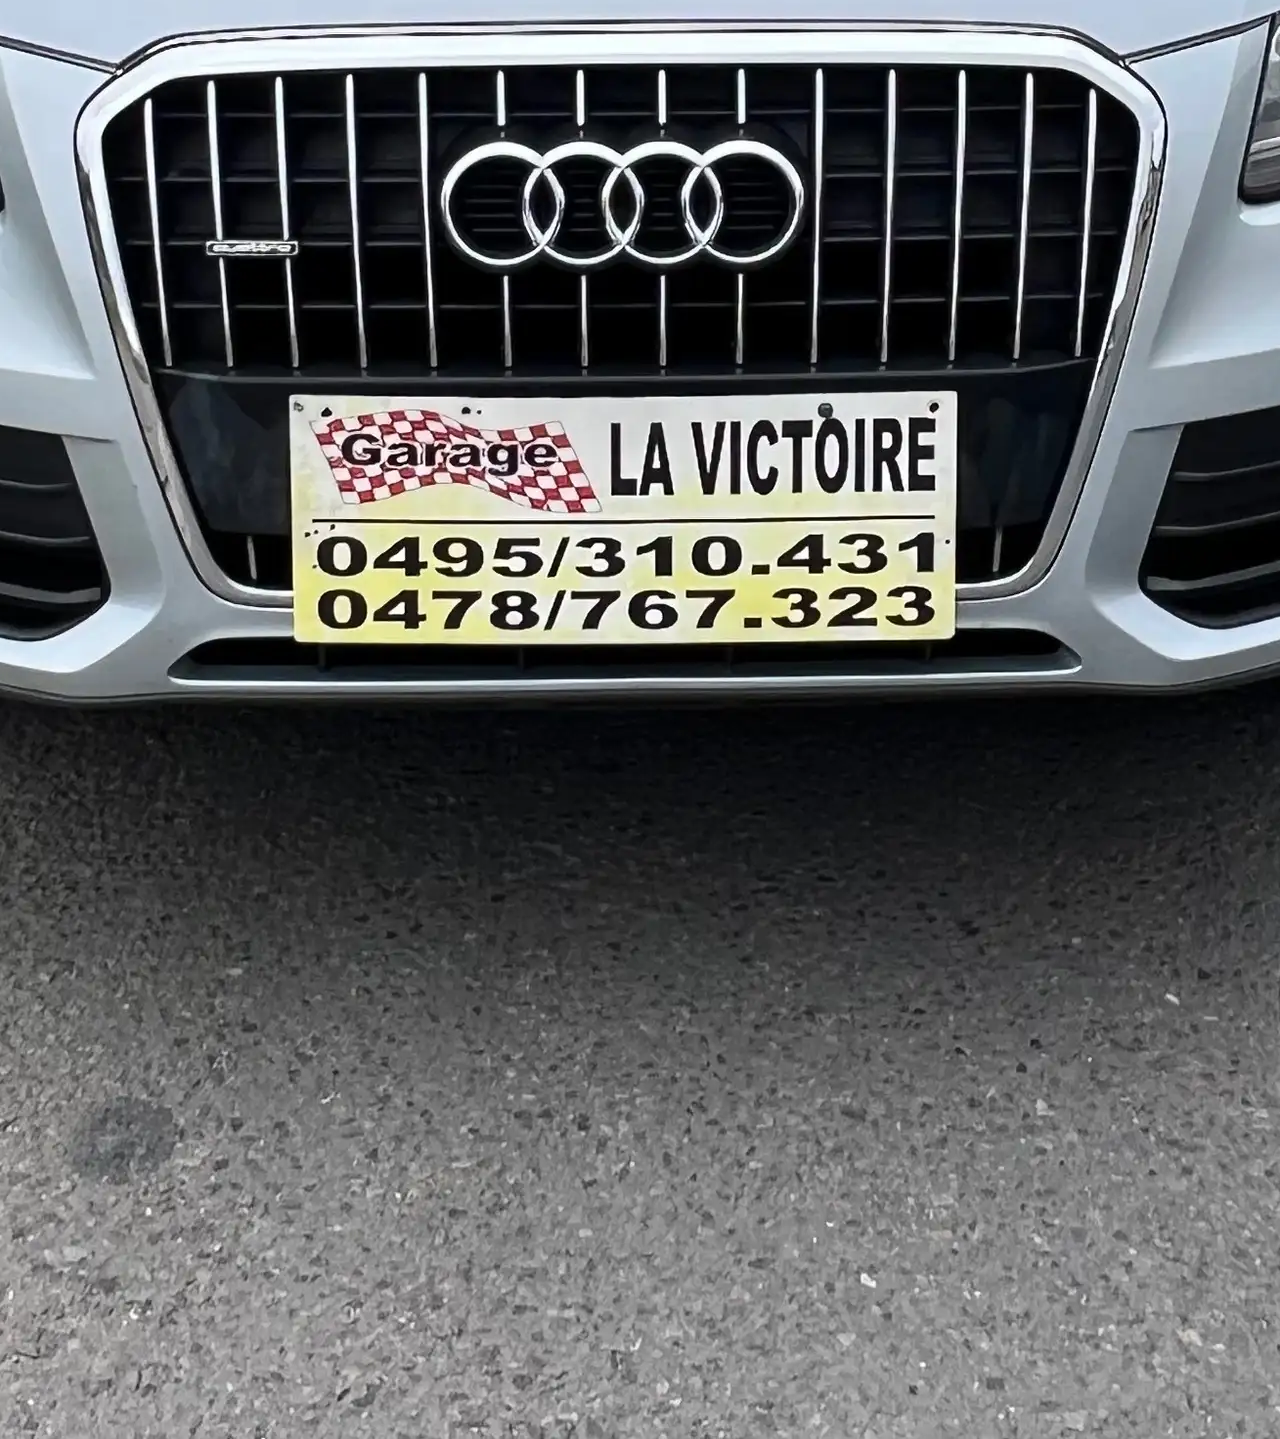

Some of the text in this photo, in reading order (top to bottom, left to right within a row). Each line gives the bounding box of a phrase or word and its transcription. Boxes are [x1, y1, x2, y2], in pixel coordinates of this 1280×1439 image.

[340, 417, 936, 496] Garage LA VICTOIRE
[318, 532, 936, 578] 0495/310.431
[318, 585, 936, 631] 0478/767.323
